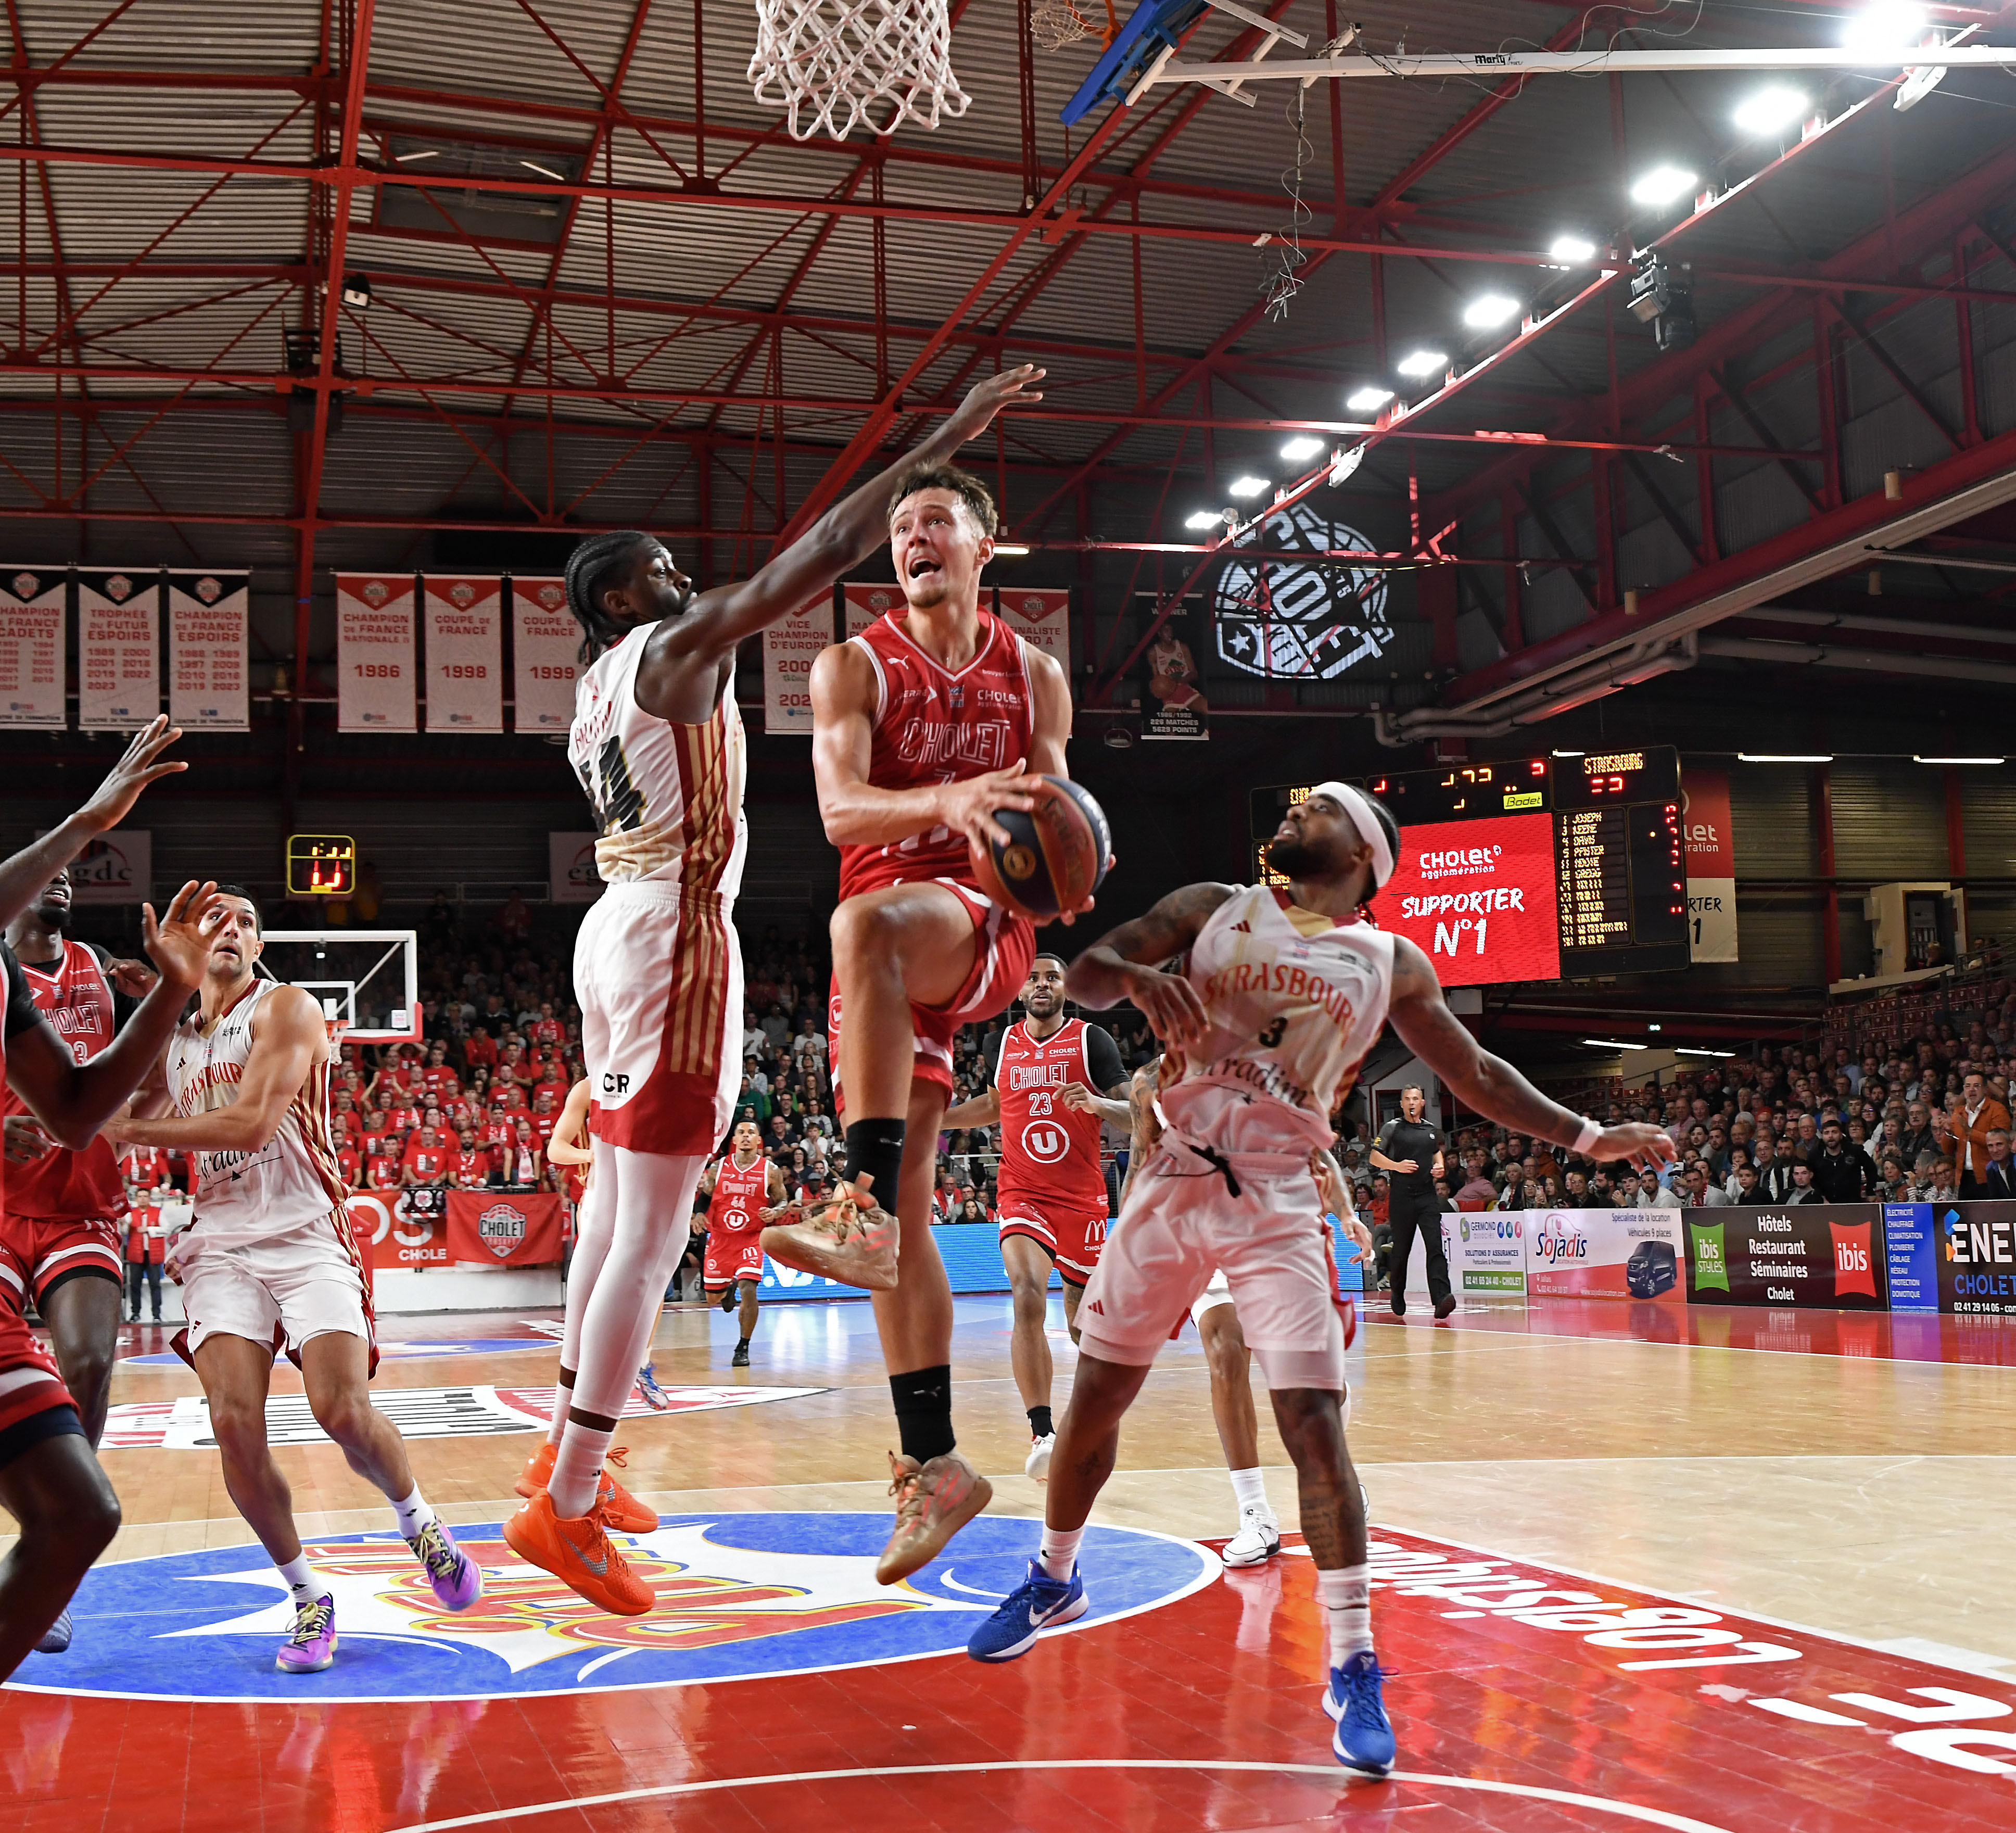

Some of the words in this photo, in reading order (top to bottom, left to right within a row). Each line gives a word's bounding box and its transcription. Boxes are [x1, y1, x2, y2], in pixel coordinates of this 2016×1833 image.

[175, 611, 242, 620] CHAMPION
[344, 614, 409, 623] CHAMPION
[435, 615, 473, 624] COUPE
[524, 617, 561, 625] COUPE
[107, 621, 148, 629] FUTUR
[192, 622, 242, 631] FRANCE
[359, 625, 409, 634] FRANCE
[438, 626, 487, 635] FRANCE
[87, 631, 150, 641] ESPOIRS
[178, 633, 240, 642] ESPOIRS
[527, 628, 575, 636] FRANCE
[771, 641, 828, 650] D'EUROPE
[354, 665, 400, 677] 1986
[441, 666, 487, 678] 1998
[779, 660, 813, 672] 200
[530, 666, 575, 679] 1999
[898, 717, 1010, 768] CHOLET
[1506, 796, 1541, 807] Bodet
[1402, 888, 1525, 918] SUPPORTER
[1259, 1016, 1288, 1048] 3
[1010, 1061, 1069, 1091] CHOLET
[603, 1073, 629, 1093] CR
[1029, 1092, 1053, 1116] 23
[1031, 1131, 1058, 1154] U
[480, 1220, 525, 1236] CHOLET
[1757, 1215, 1792, 1232] Hôtels
[1536, 1233, 1587, 1264] Sojadis
[1699, 1239, 1719, 1259] ibis
[1748, 1239, 1806, 1255] Restaurant
[1837, 1243, 1868, 1271] ibis
[1751, 1259, 1808, 1278] Séminaires
[1767, 1287, 1795, 1300] Cholet
[1954, 1302, 1961, 1311] 02
[1961, 1303, 1971, 1311] 41
[1972, 1303, 1981, 1312] 29
[1981, 1303, 1990, 1312] 14
[1990, 1303, 1999, 1312] 06
